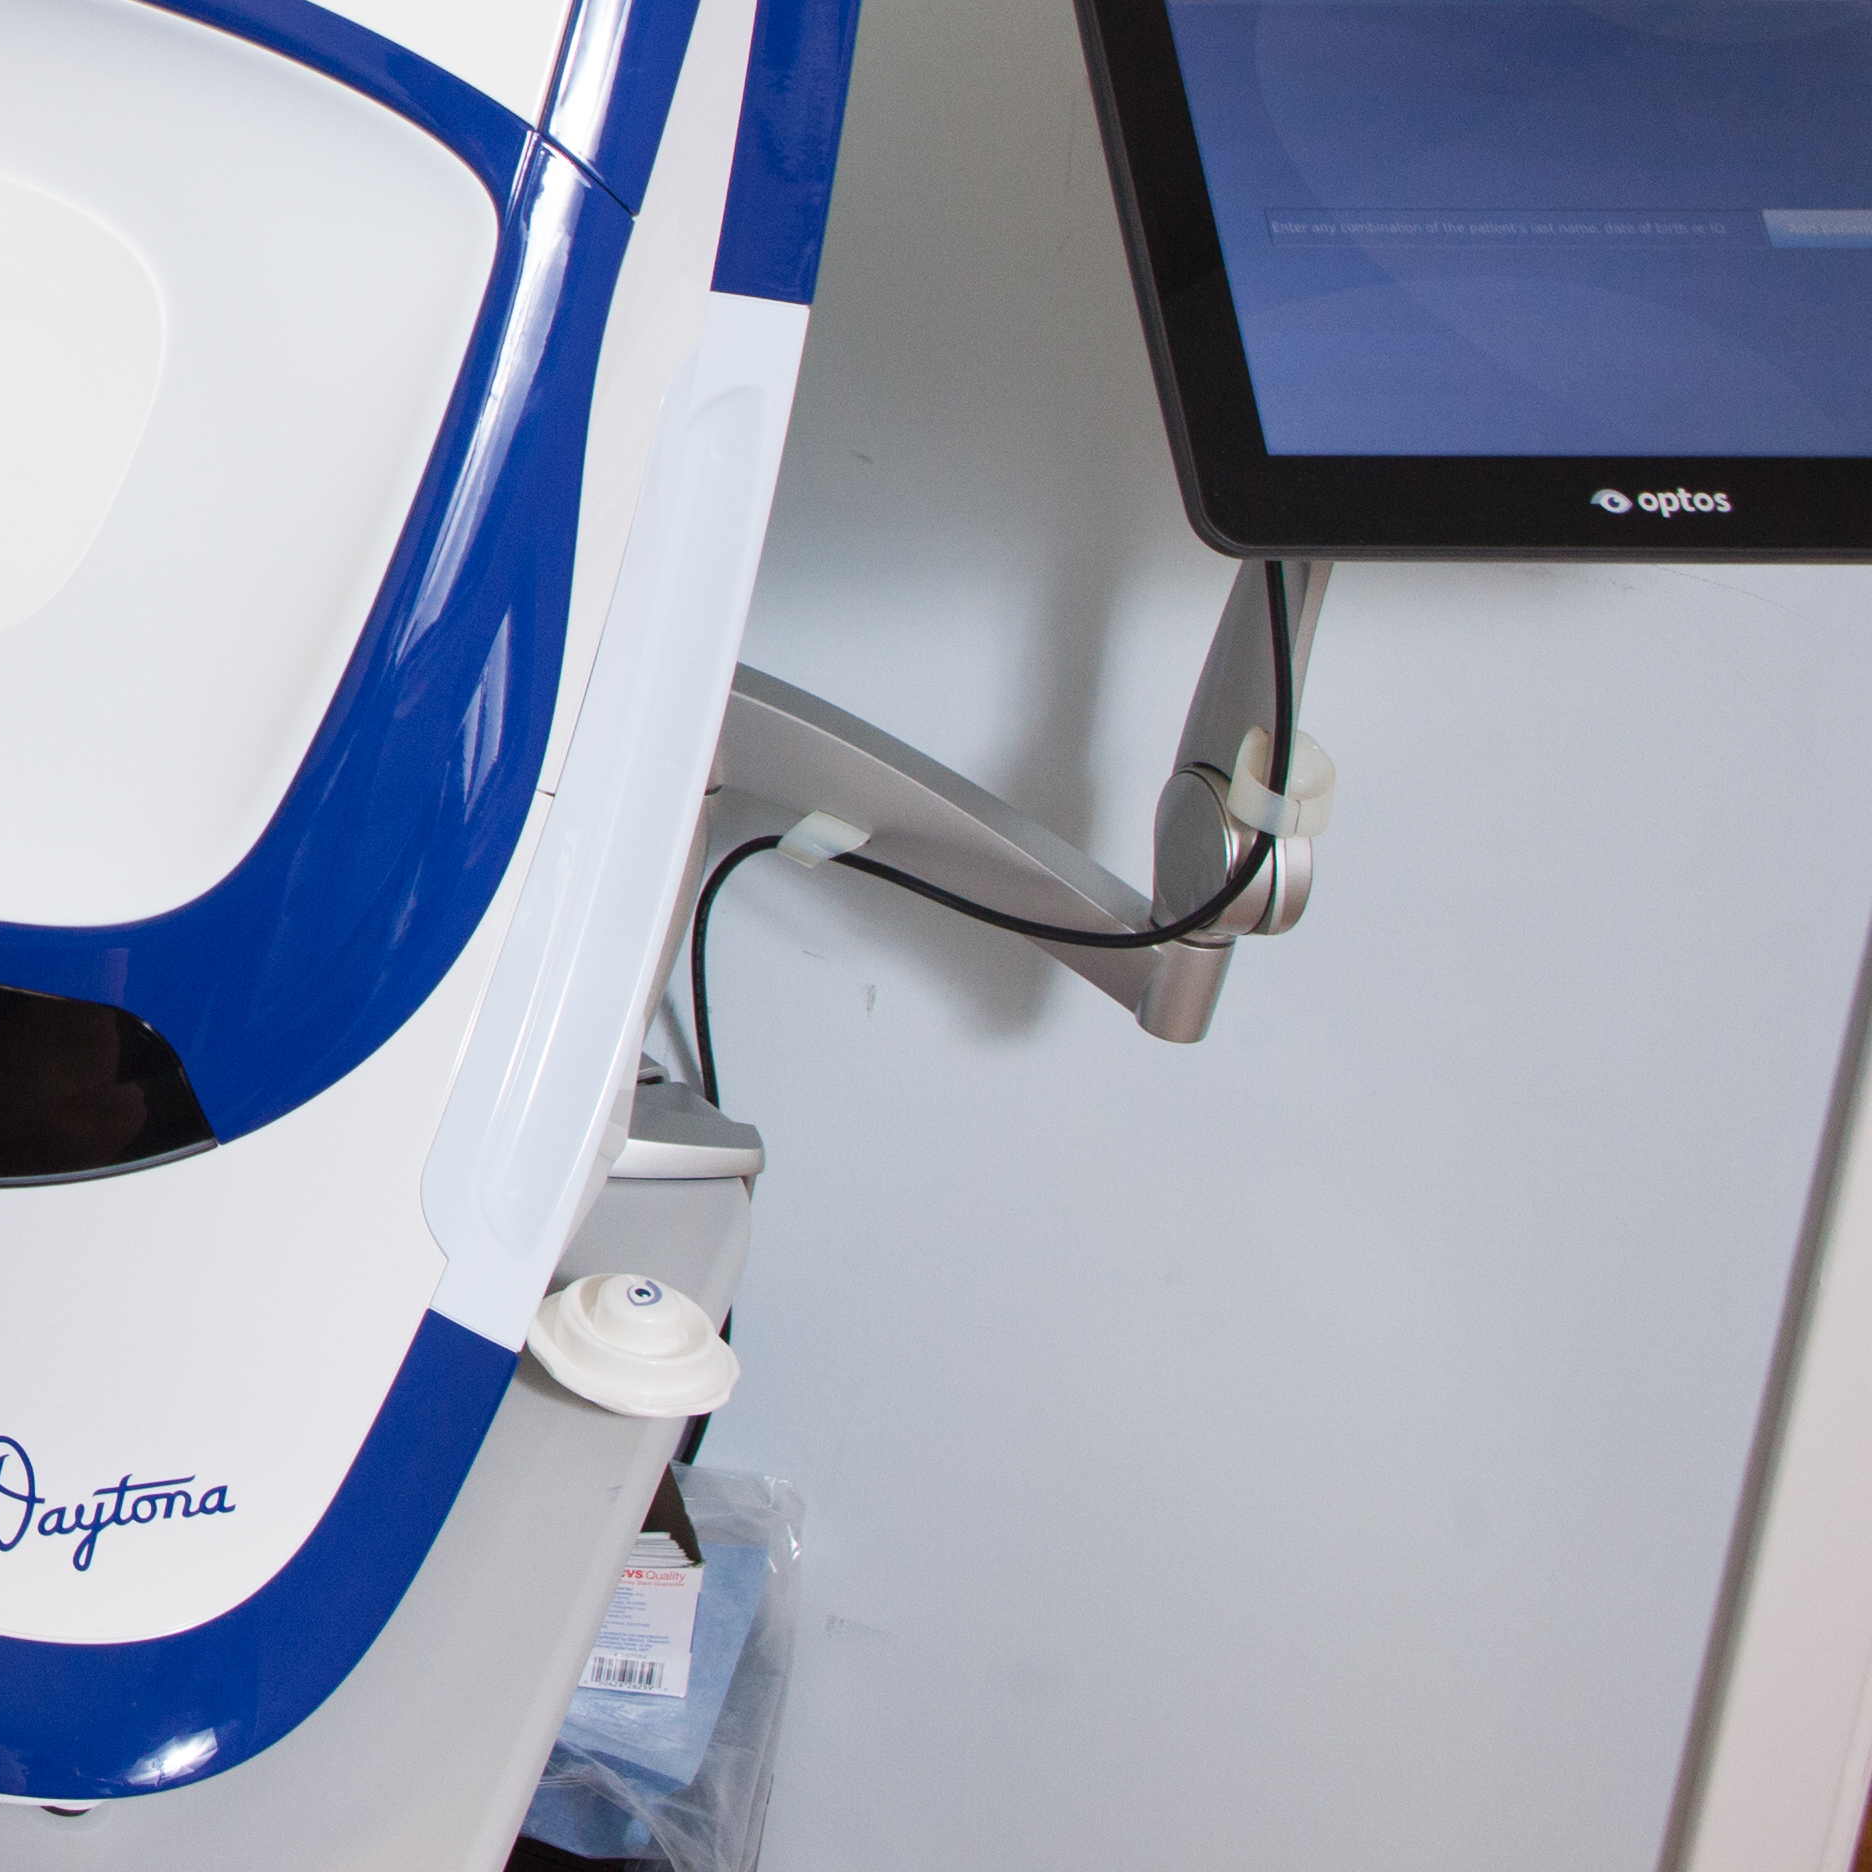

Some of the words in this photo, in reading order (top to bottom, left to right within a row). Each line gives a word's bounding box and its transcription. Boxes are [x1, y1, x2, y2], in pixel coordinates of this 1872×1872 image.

[1271, 220, 1308, 233] Enter
[1312, 223, 1336, 235] any
[1442, 221, 1465, 233] the
[1638, 486, 1732, 518] optos
[646, 1570, 685, 1581] Quality
